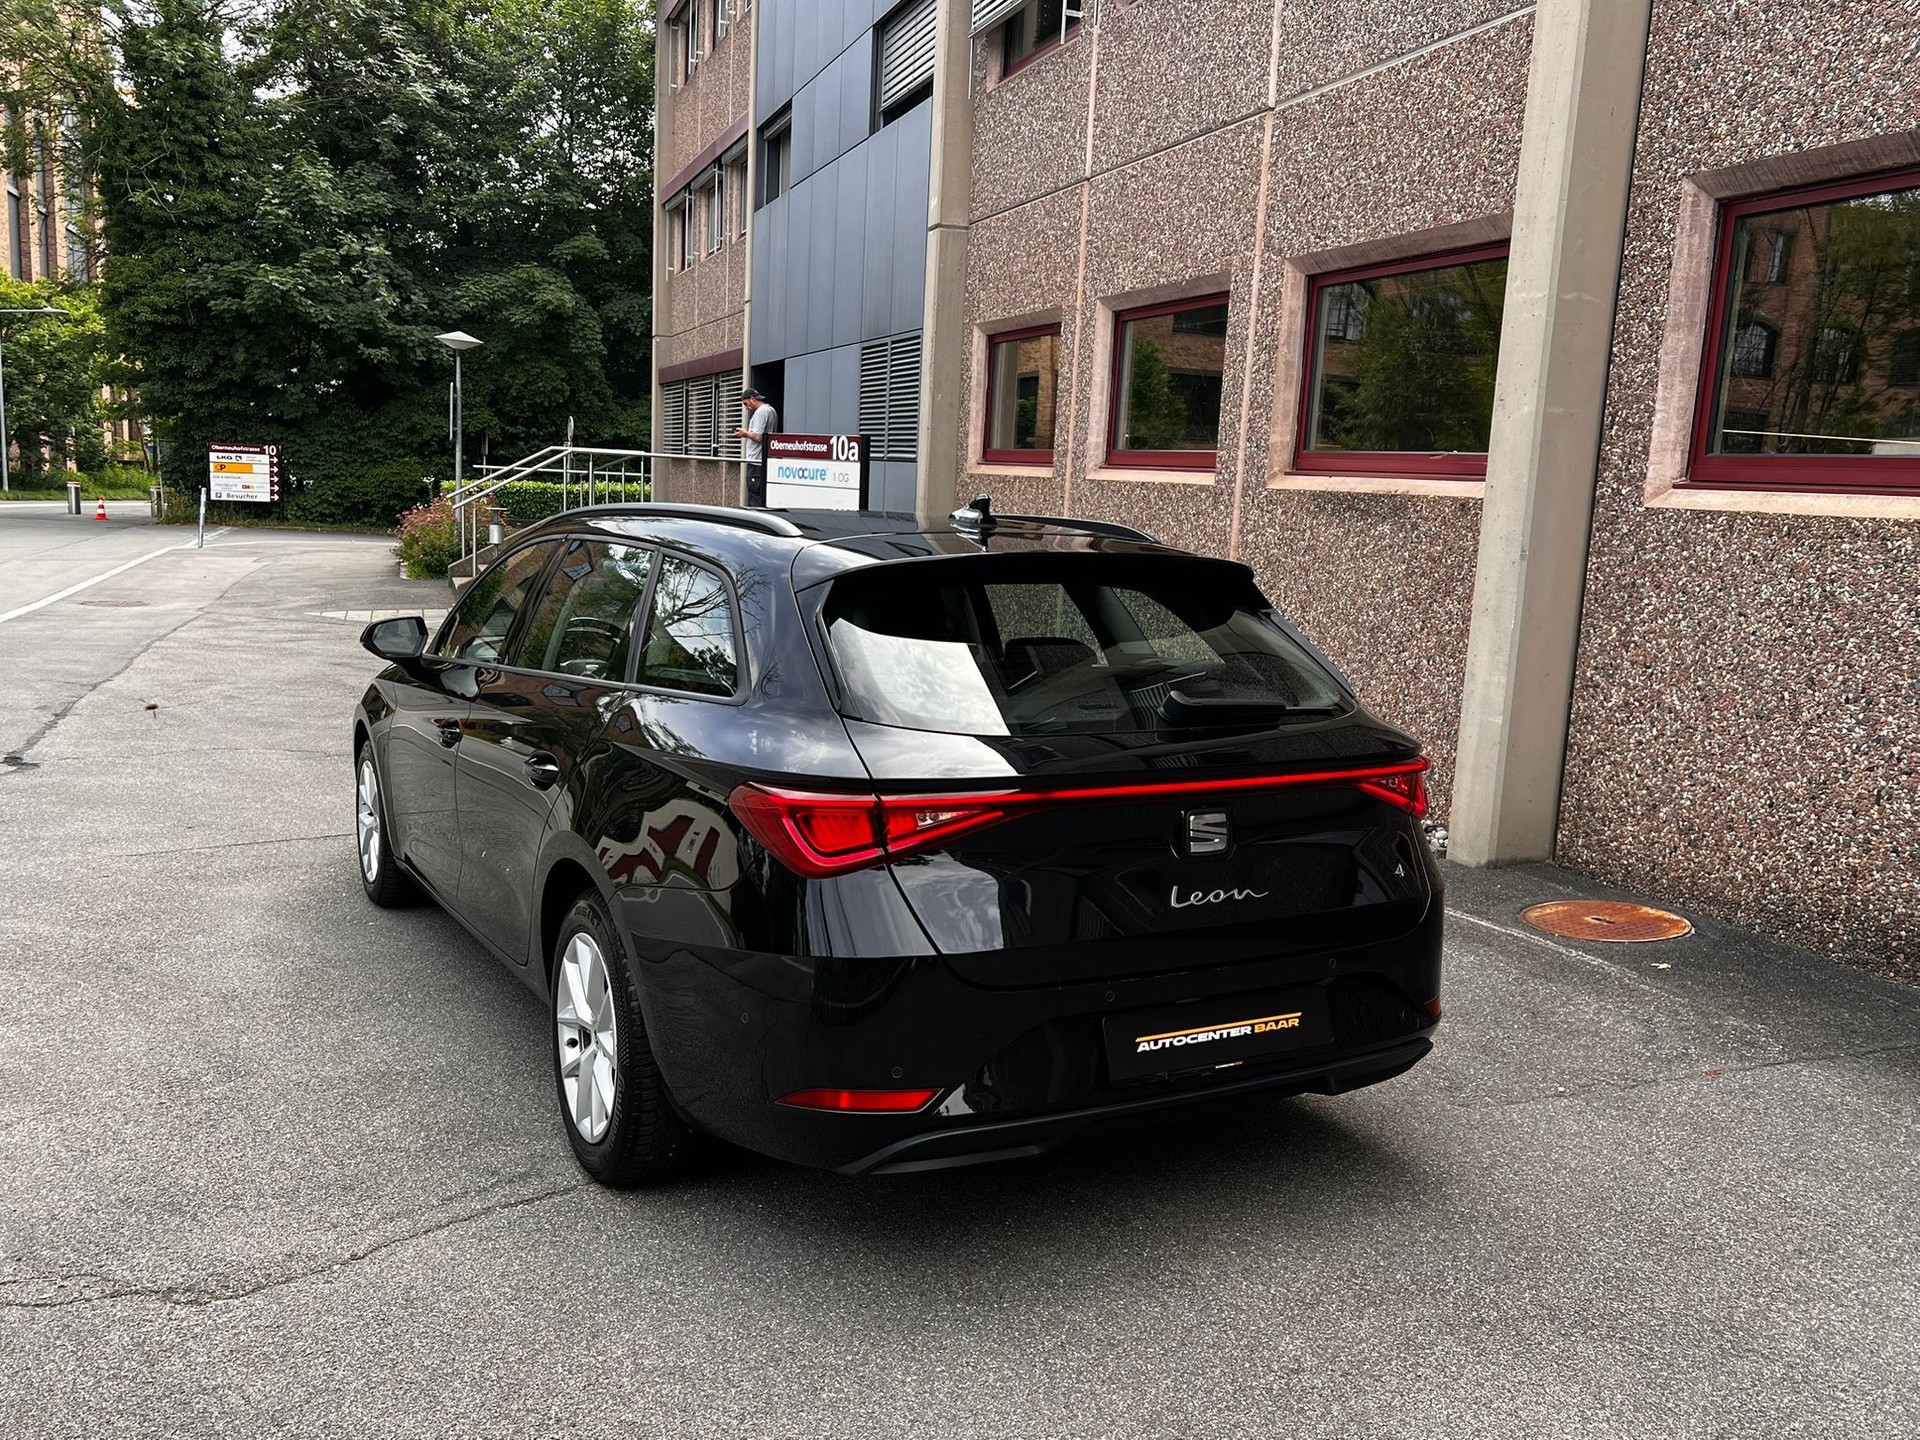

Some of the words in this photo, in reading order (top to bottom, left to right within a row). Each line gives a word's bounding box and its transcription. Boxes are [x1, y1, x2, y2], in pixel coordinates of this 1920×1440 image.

[211, 444, 261, 452] Oberneuhofstrasse
[263, 445, 277, 455] 10
[770, 439, 828, 452] Oberneuhofstrasse
[829, 435, 859, 461] 10a
[226, 492, 258, 500] Besucher
[1394, 863, 1405, 877] 4
[1171, 885, 1269, 908] Leon
[1136, 1025, 1252, 1053] AUTOCENTER
[1254, 1018, 1300, 1034] BAAR
